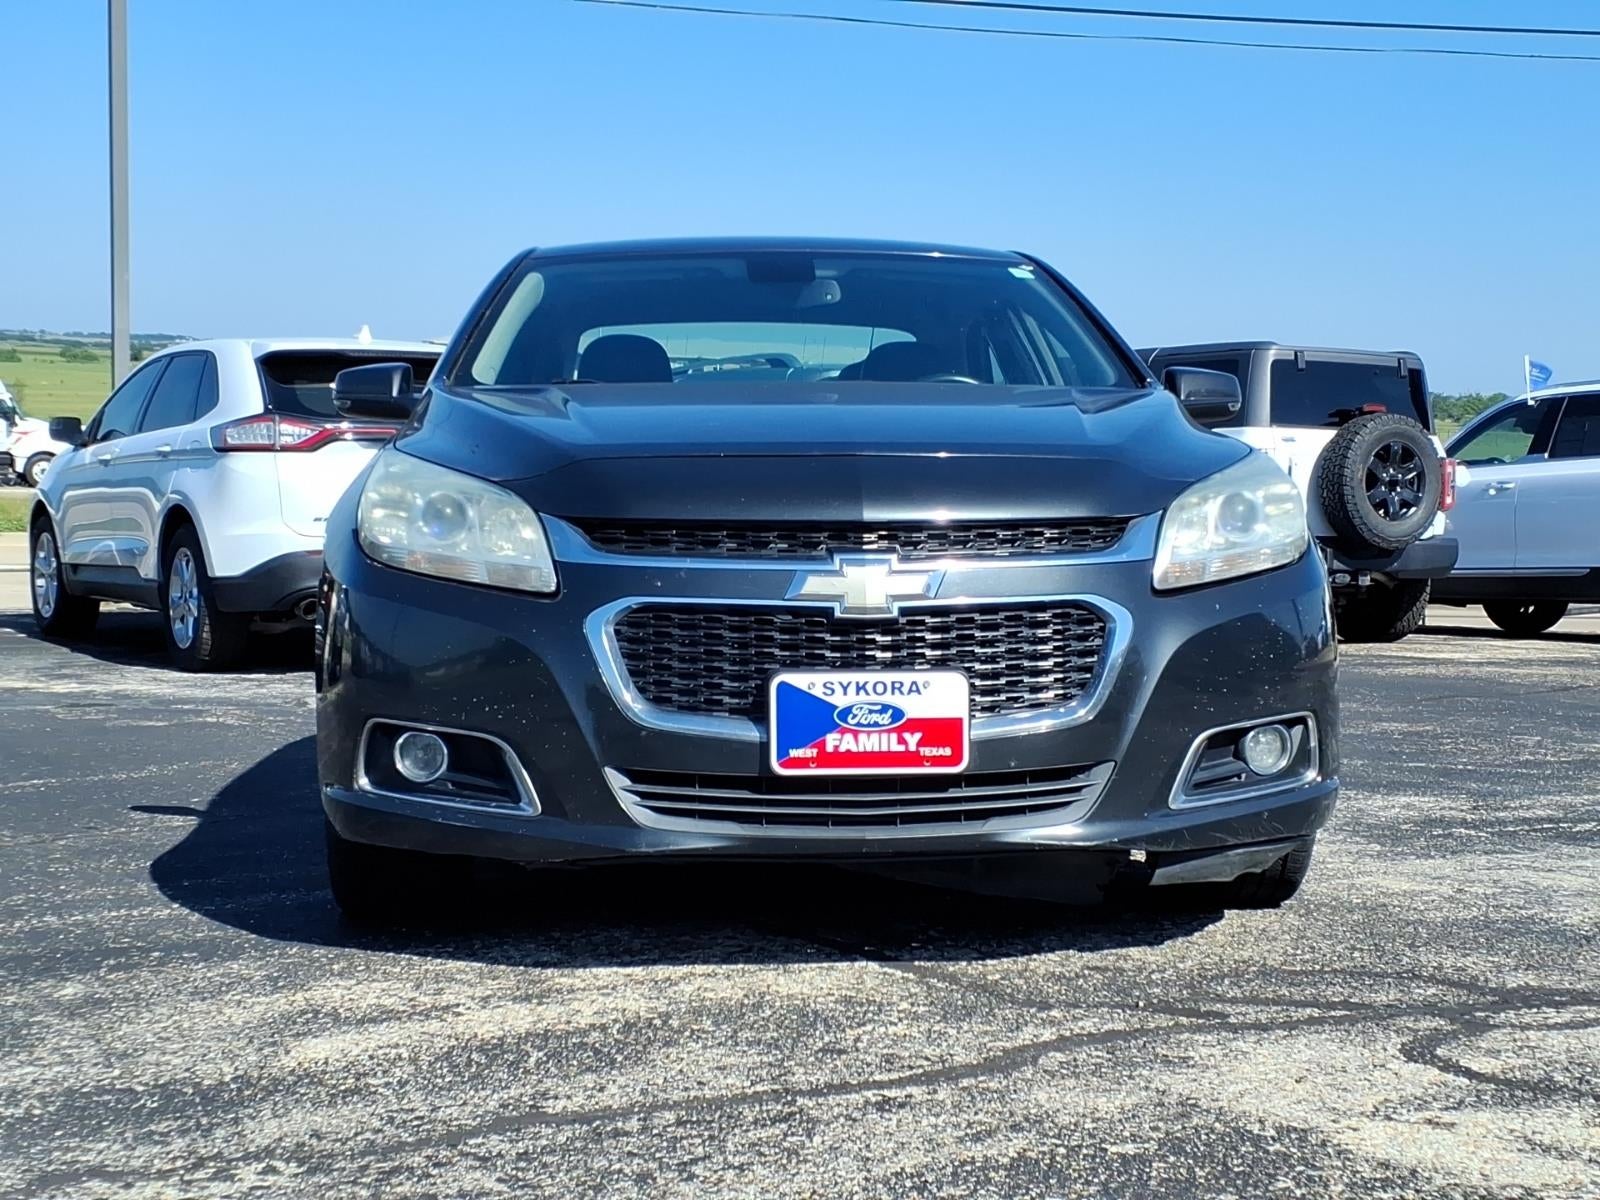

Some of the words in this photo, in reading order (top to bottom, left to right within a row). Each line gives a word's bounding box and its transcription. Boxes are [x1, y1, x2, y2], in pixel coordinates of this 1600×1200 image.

[822, 680, 922, 696] SYKORA
[847, 703, 893, 726] Ford
[825, 732, 923, 753] FAMILY
[789, 748, 818, 758] WEST
[919, 747, 952, 757] TEXAS
